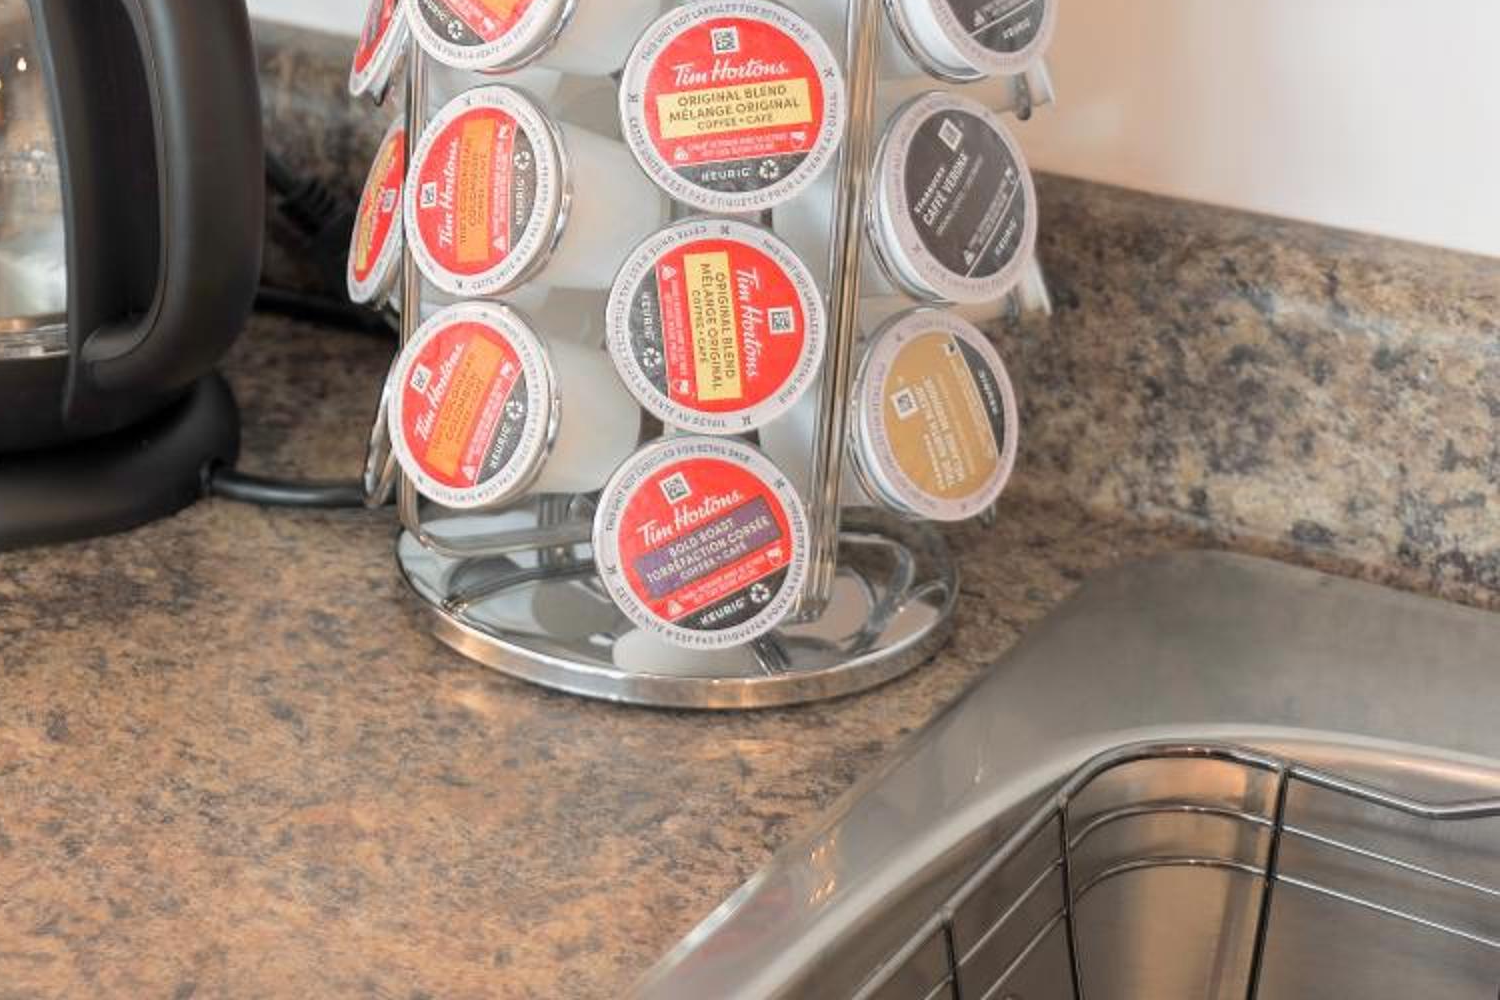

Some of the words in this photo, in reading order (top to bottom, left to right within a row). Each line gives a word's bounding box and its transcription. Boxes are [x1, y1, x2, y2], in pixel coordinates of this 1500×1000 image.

[672, 62, 708, 87] Tim
[668, 103, 731, 123] MÉLANGE
[734, 98, 800, 114] ORIGINAL
[677, 90, 740, 107] ORIGINAL
[744, 84, 787, 100] BLEND
[696, 117, 738, 131] COFFEE
[745, 111, 773, 125] CAFÉ
[701, 167, 750, 181] KEURIG
[941, 150, 969, 195] VERONA
[512, 177, 526, 225] KEURIG
[435, 211, 454, 248] Tim
[699, 262, 718, 324] MÉLANGE
[713, 270, 731, 334] ORIGINAL
[734, 266, 761, 302] Tim
[639, 291, 654, 340] KEURIG
[691, 289, 704, 329] COFFEE
[696, 337, 709, 364] CAFÉ
[706, 327, 724, 391] ORIGINAL
[721, 336, 736, 379] BLEND
[410, 404, 437, 443] Tim
[488, 421, 512, 470] KEURIG
[633, 514, 675, 548] Tim
[644, 537, 728, 584] TORRÉFACTION
[725, 514, 771, 544] CORSÉE
[667, 536, 699, 558] BOLD
[698, 517, 736, 544] ROAST
[678, 554, 718, 579] COFFEE
[698, 597, 746, 625] KEURIG
